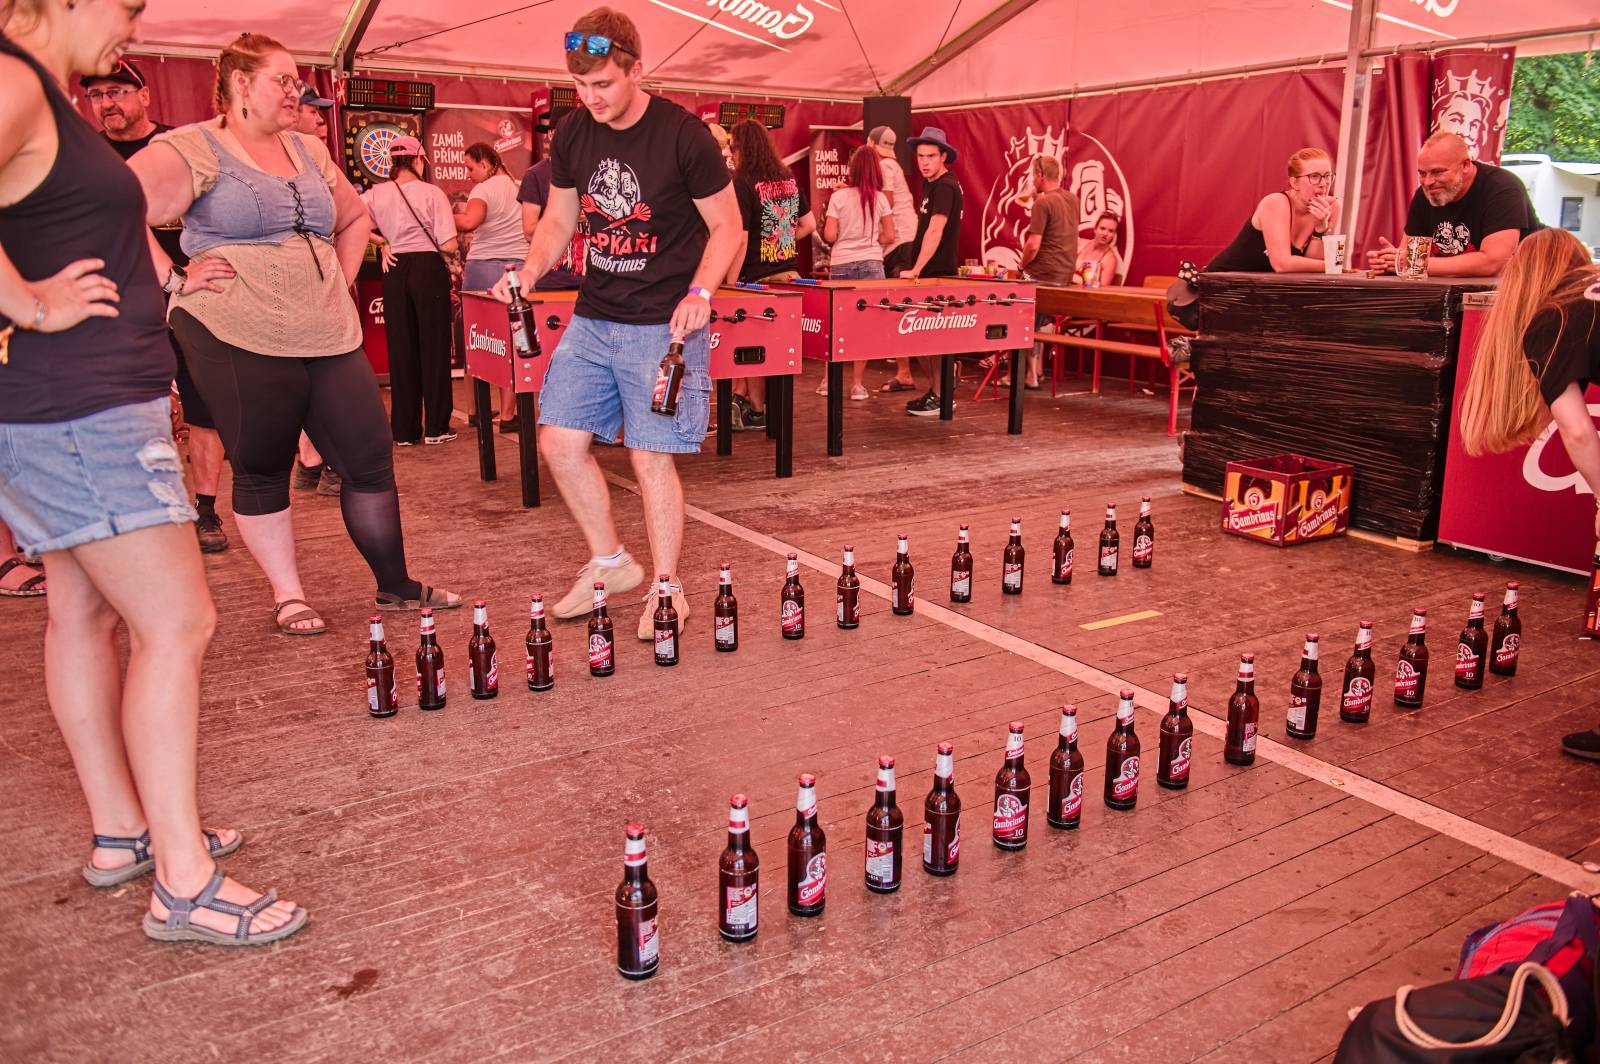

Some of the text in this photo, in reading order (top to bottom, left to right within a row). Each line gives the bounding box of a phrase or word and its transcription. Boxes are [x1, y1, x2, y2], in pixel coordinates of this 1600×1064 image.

[431, 131, 464, 147] ZAMIŘ
[815, 149, 838, 162] ZAMIŘ
[435, 166, 471, 181] GAMB
[816, 163, 839, 176] PŘÍMO
[591, 232, 658, 256] PKAŘI
[368, 297, 384, 315] Ga
[802, 314, 822, 333] inus
[898, 309, 978, 335] Gambrinus
[469, 323, 506, 357] Gambrinus
[1231, 509, 1275, 529] Gambrinus
[1300, 505, 1336, 537] Gambrinus
[993, 814, 1026, 829] Gambrinus
[1014, 828, 1024, 837] 10
